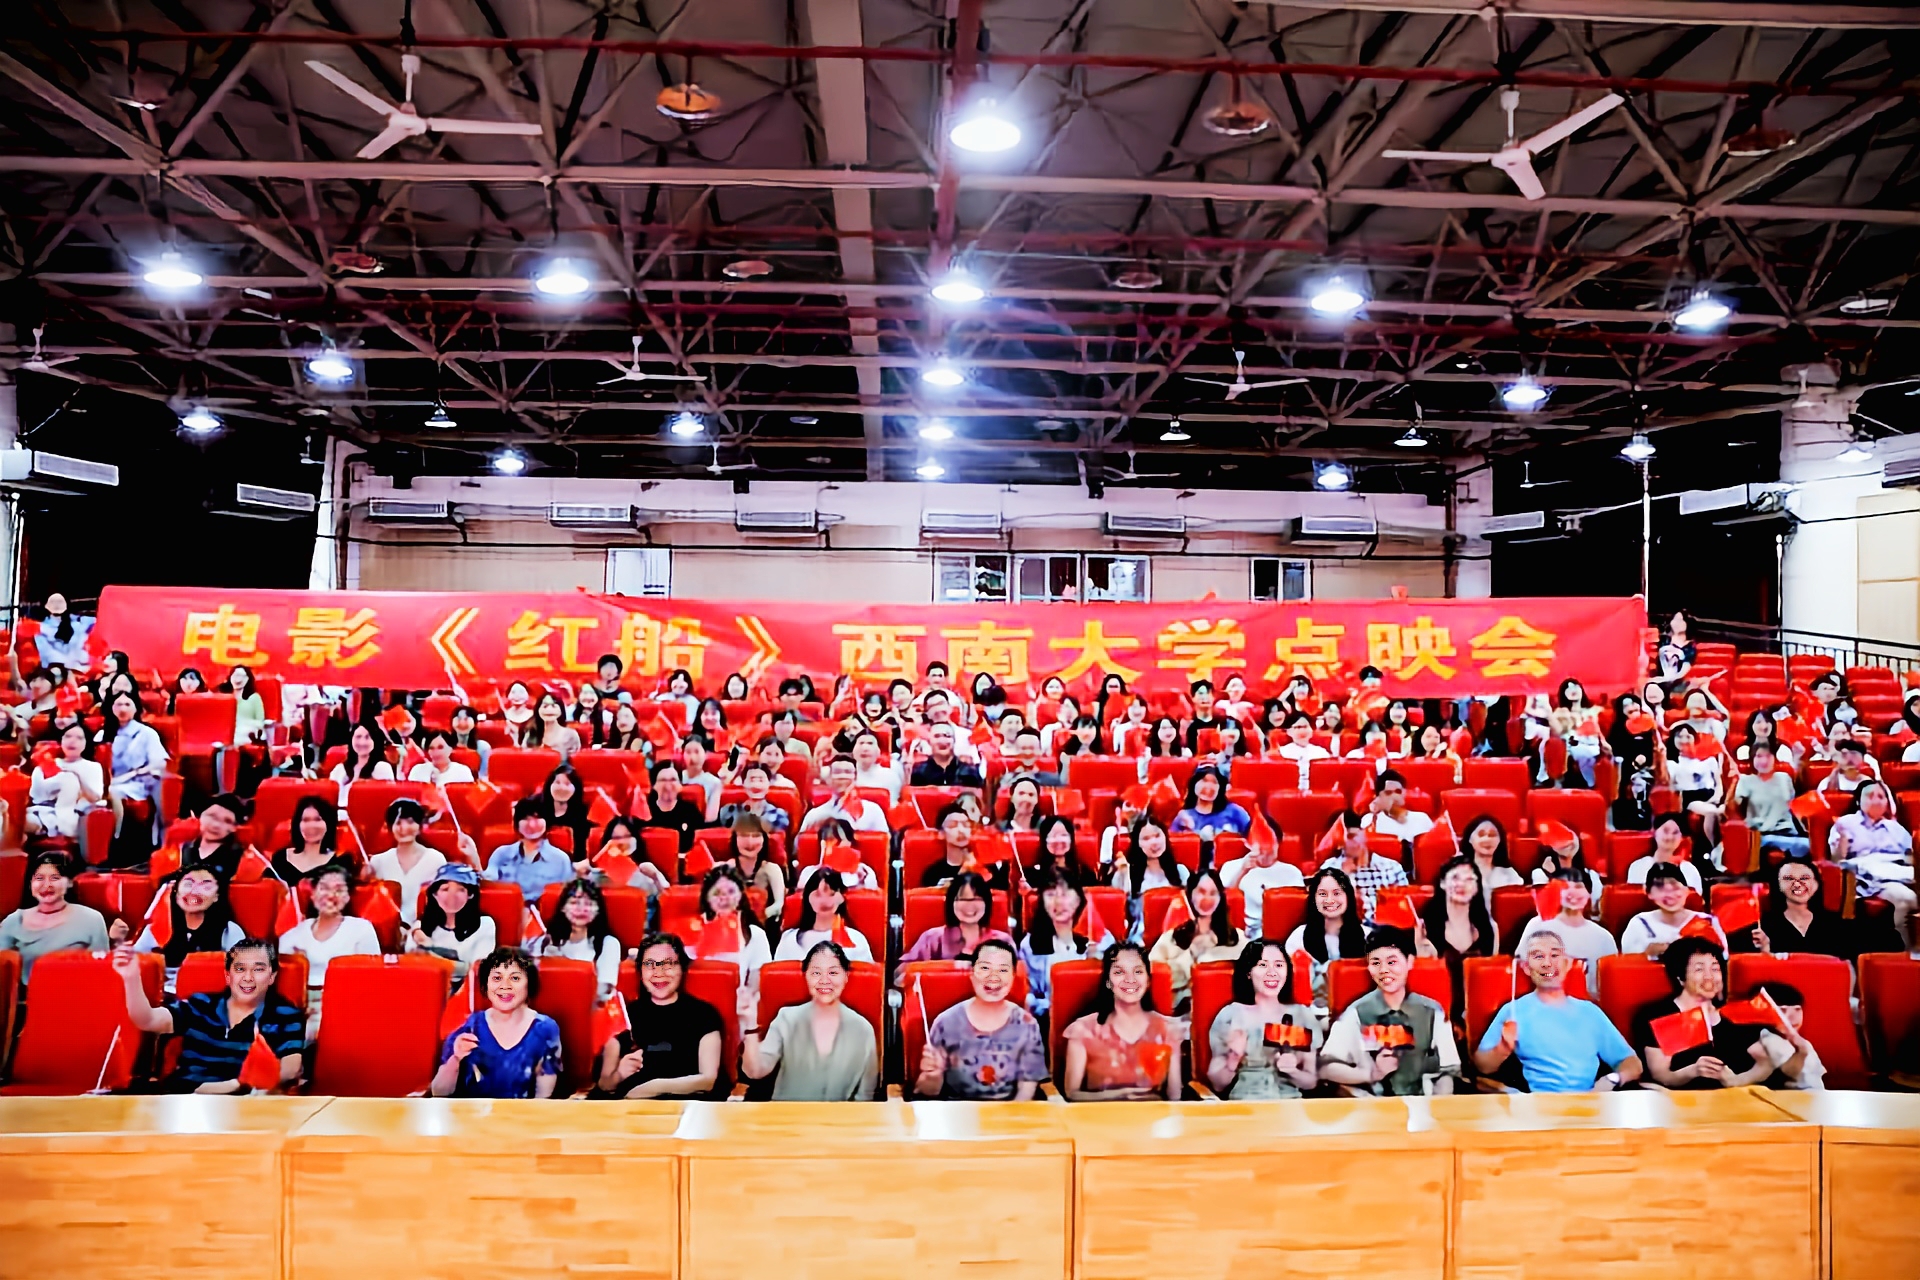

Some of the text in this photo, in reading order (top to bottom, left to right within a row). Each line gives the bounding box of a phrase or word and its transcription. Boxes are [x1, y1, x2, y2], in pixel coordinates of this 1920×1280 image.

[181, 603, 1557, 684] 电影《红船》西南大学点映会
